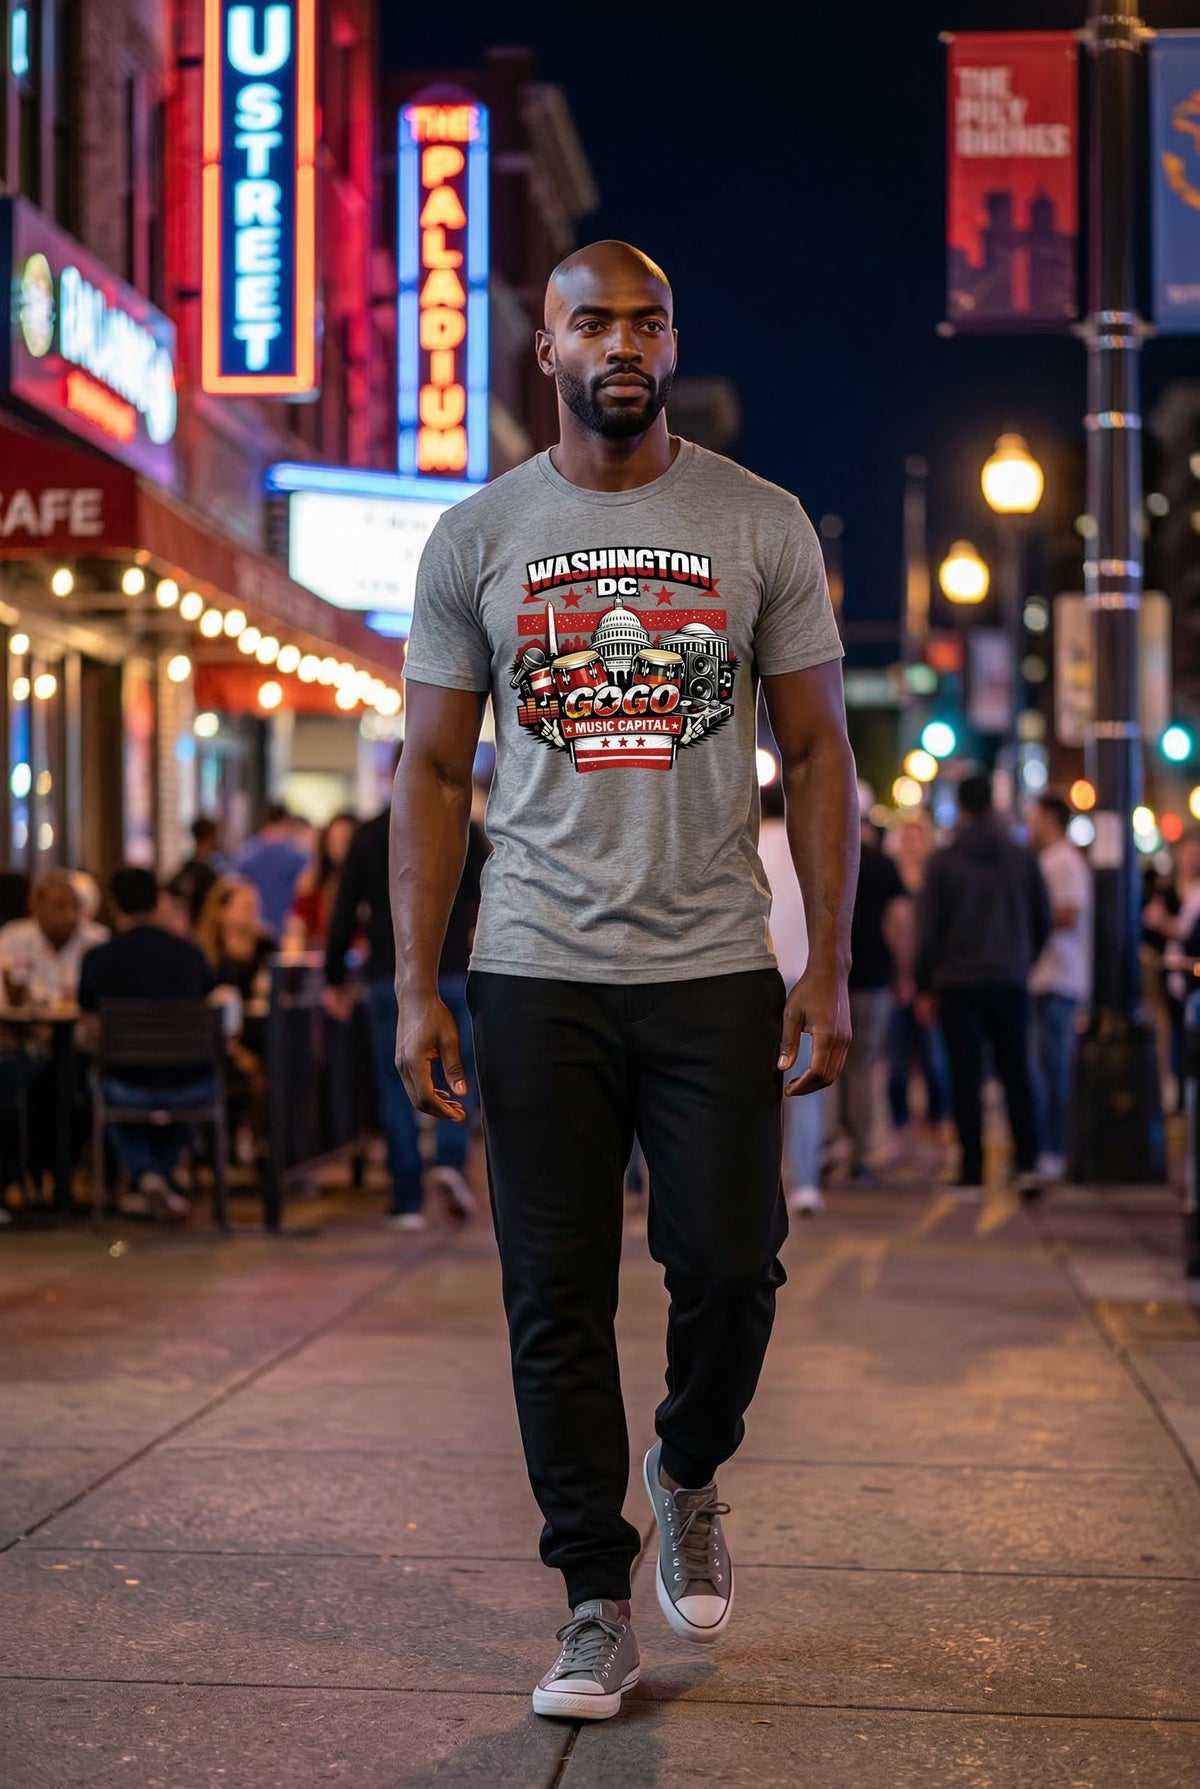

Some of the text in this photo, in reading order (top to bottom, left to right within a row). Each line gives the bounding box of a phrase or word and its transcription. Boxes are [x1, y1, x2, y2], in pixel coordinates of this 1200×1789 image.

[403, 105, 480, 142] THE
[227, 4, 292, 372] U STREET
[418, 145, 468, 472] PALADIUM
[0, 488, 104, 537] AFE
[528, 549, 711, 592] WASHINGTON
[565, 684, 680, 719] GOGO
[575, 719, 669, 734] MUSIC CAPITAL
